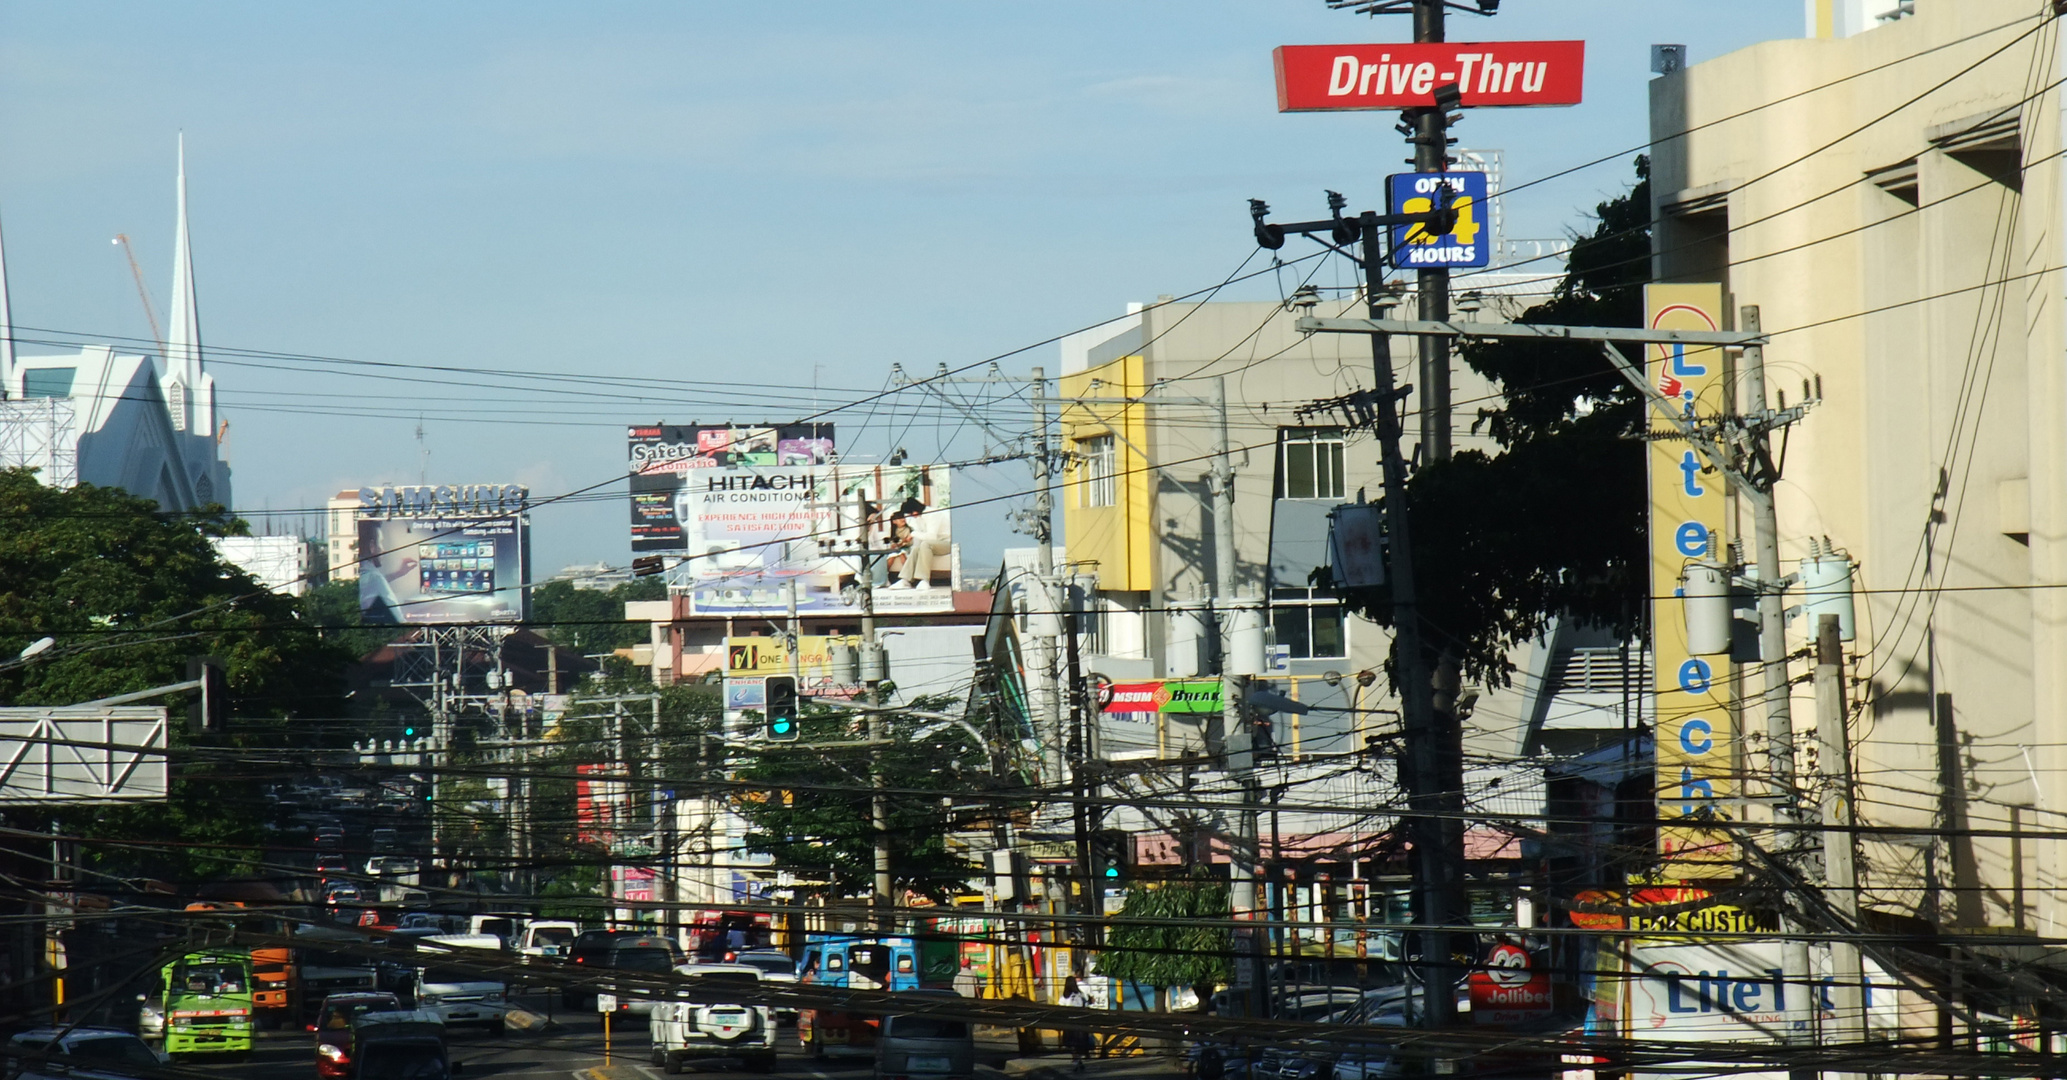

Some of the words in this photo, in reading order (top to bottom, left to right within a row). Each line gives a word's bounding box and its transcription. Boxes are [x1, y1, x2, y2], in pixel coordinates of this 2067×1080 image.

[1328, 53, 1548, 96] Drive-Thru
[1402, 196, 1480, 245] 24
[1410, 246, 1475, 263] HOURS
[634, 444, 698, 460] Safety
[641, 459, 715, 473] Automatic
[709, 475, 815, 491] HITACHI
[359, 485, 524, 513] SAMSUNG
[703, 494, 724, 503] AIR
[730, 492, 820, 502] CONDITIONER
[698, 513, 758, 522] EXPERIENCE
[762, 512, 786, 521] HIGH
[726, 522, 805, 532] SATISFACTION!
[760, 655, 782, 663] ONE
[784, 654, 823, 663] MNGO
